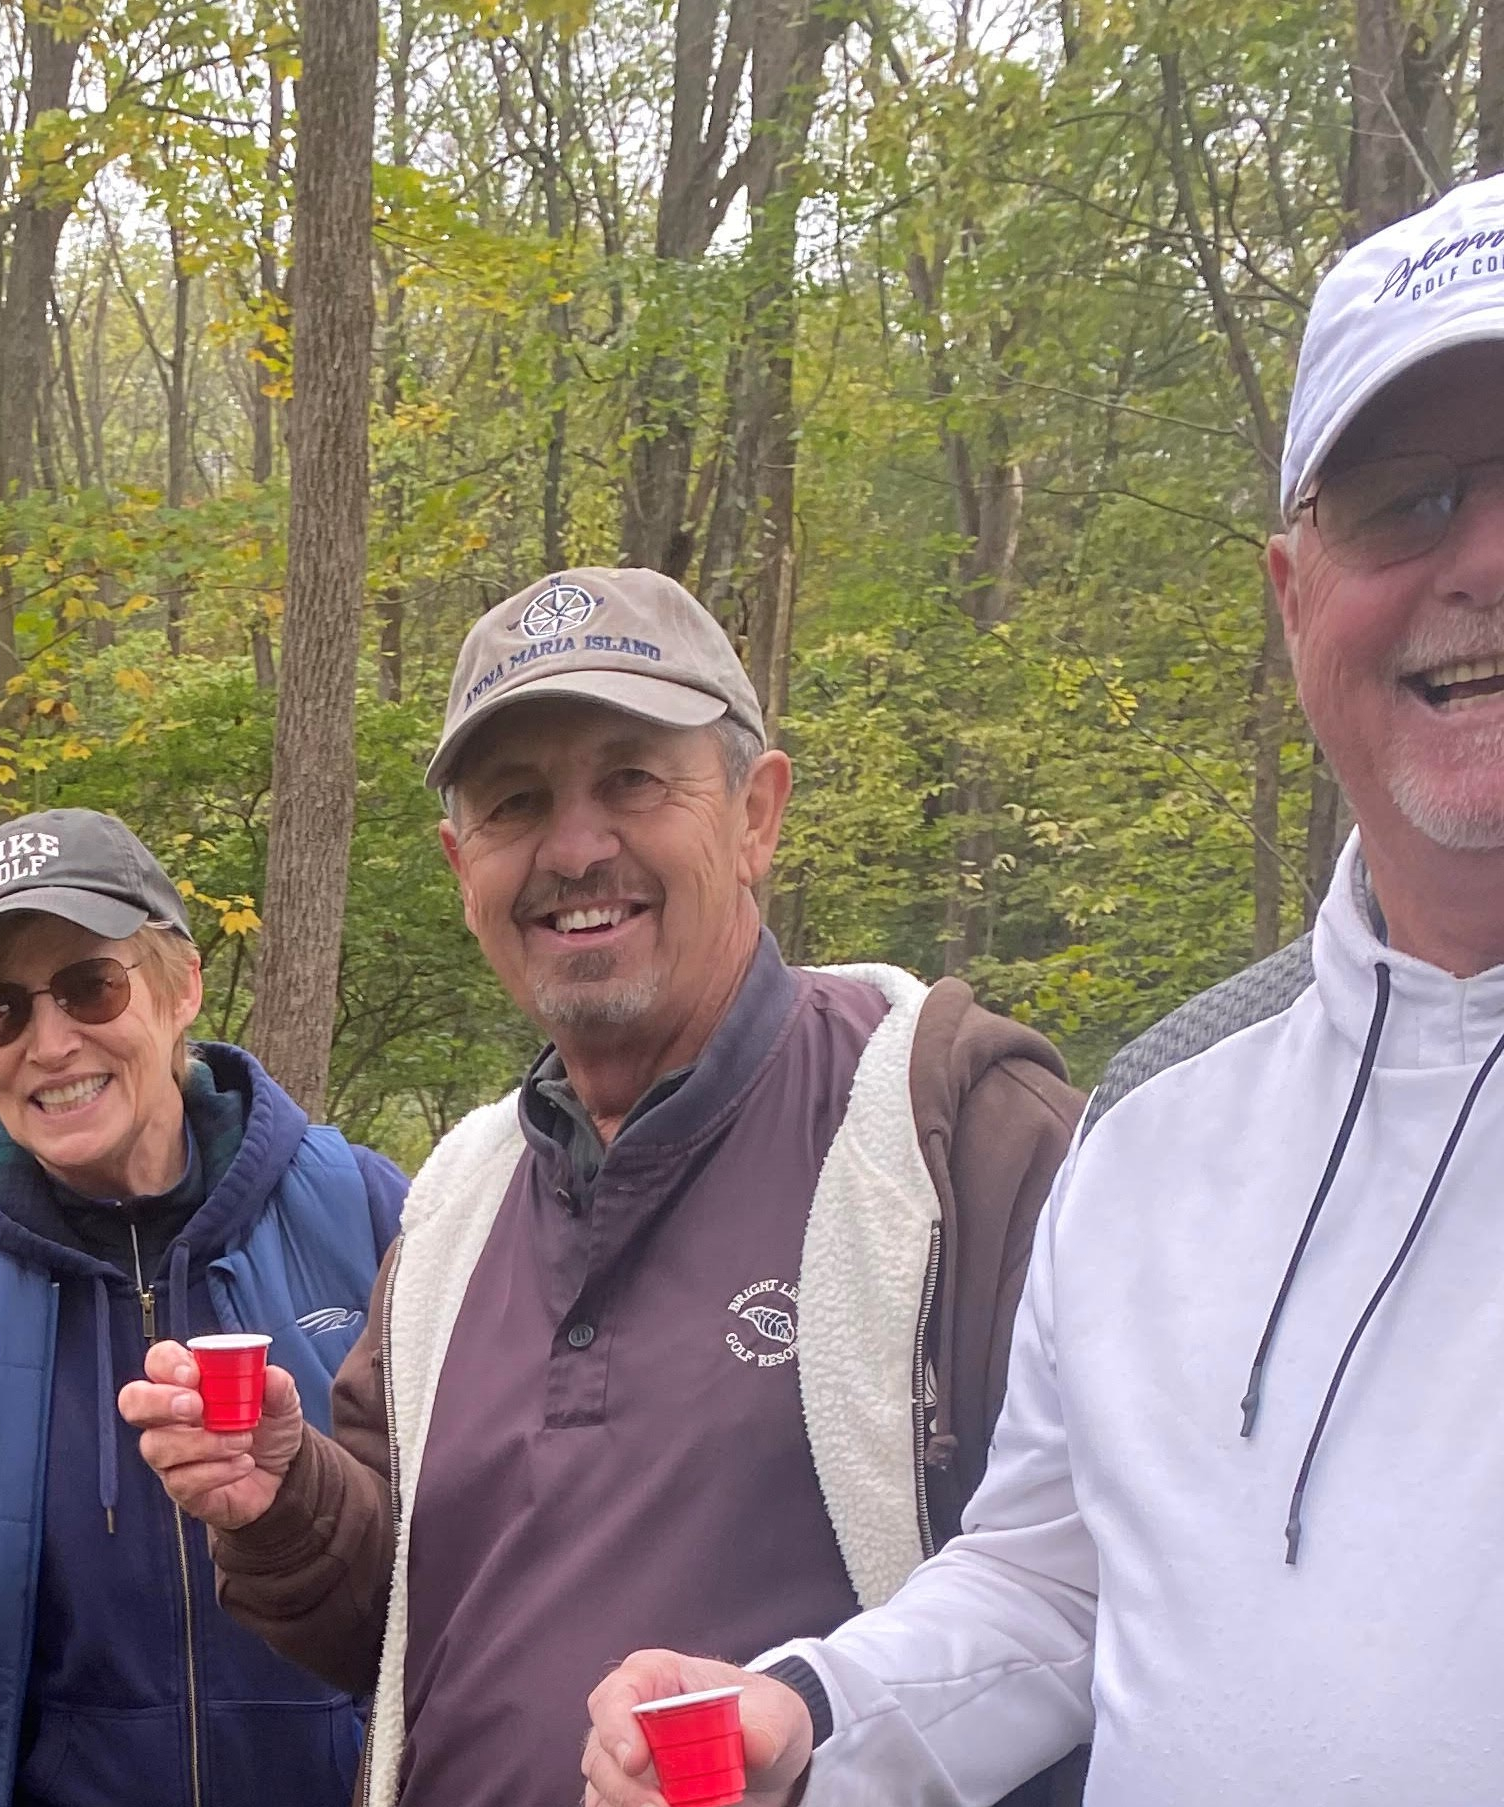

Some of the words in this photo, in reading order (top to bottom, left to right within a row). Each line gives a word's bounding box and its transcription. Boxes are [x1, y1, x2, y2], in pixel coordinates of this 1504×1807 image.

[1412, 266, 1458, 301] GOLF
[1473, 255, 1504, 275] CO
[464, 664, 504, 712] ANNA
[510, 637, 576, 671] MARIA
[584, 634, 661, 661] ISLAND
[728, 1279, 779, 1313] BRIGHT
[778, 1283, 800, 1303] LE
[726, 1332, 755, 1362] GOLF
